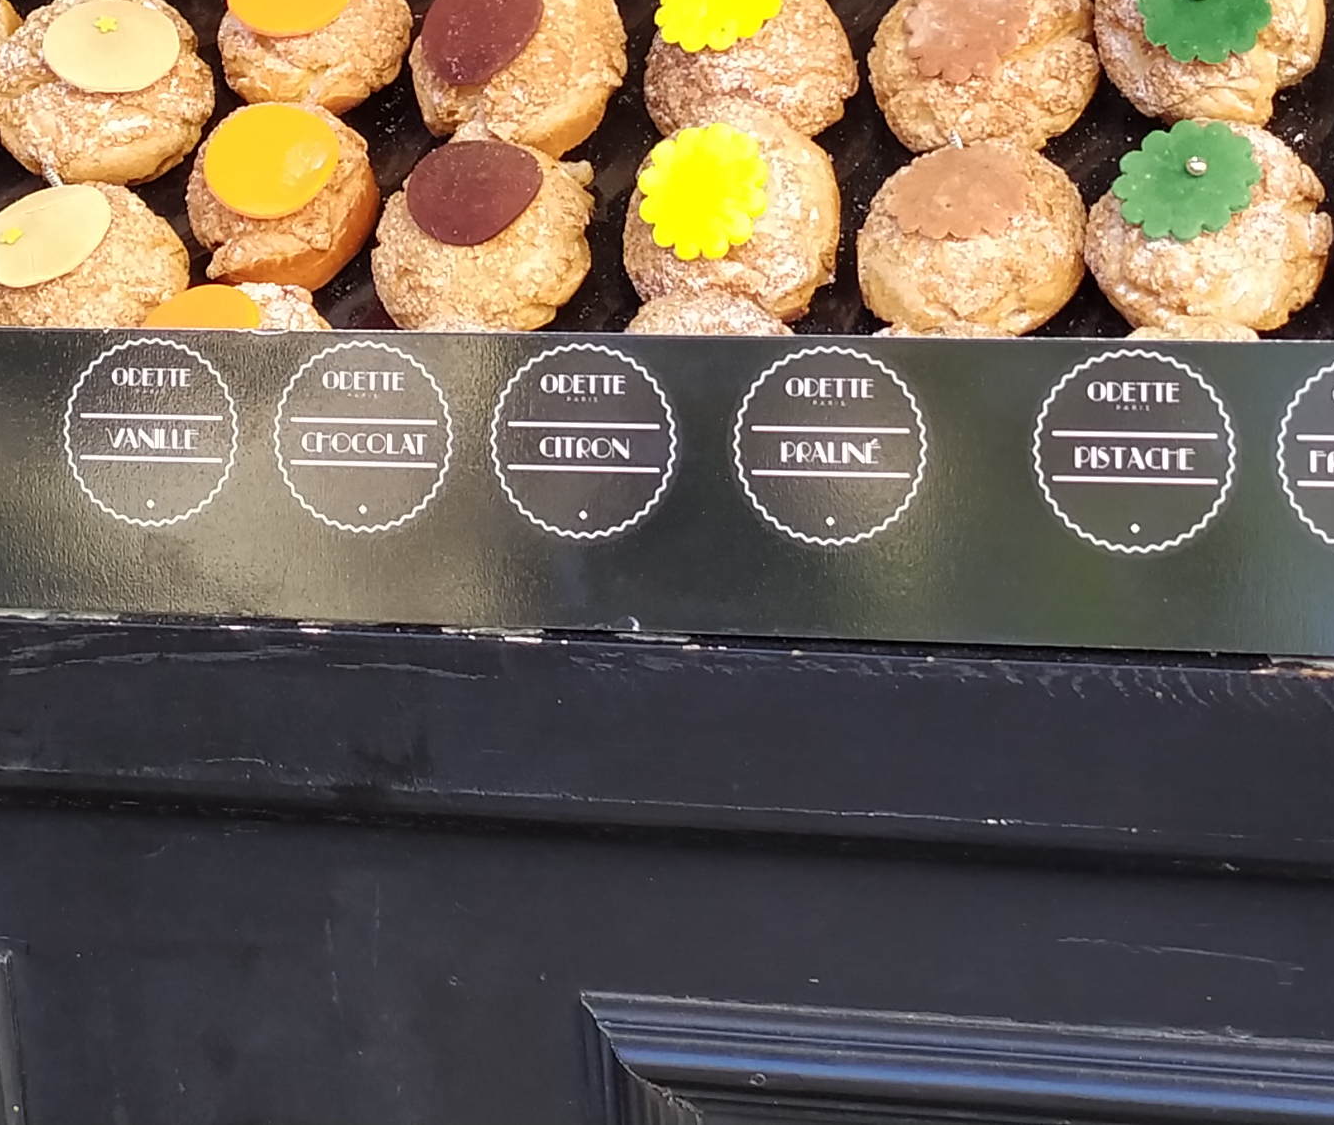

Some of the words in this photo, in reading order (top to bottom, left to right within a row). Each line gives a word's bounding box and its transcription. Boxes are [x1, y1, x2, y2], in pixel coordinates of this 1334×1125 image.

[112, 368, 191, 387] ODETTE
[323, 371, 404, 391] ODETTE
[540, 373, 626, 395] ODETTE
[785, 377, 874, 399] ODETTE
[1087, 381, 1180, 403] ODETTE
[106, 428, 199, 449] VANILLE
[302, 432, 427, 456] CHOCOLAT
[539, 436, 629, 459] CITRON
[781, 439, 880, 464] PRALINÉ
[1074, 446, 1196, 471] PISTACHE
